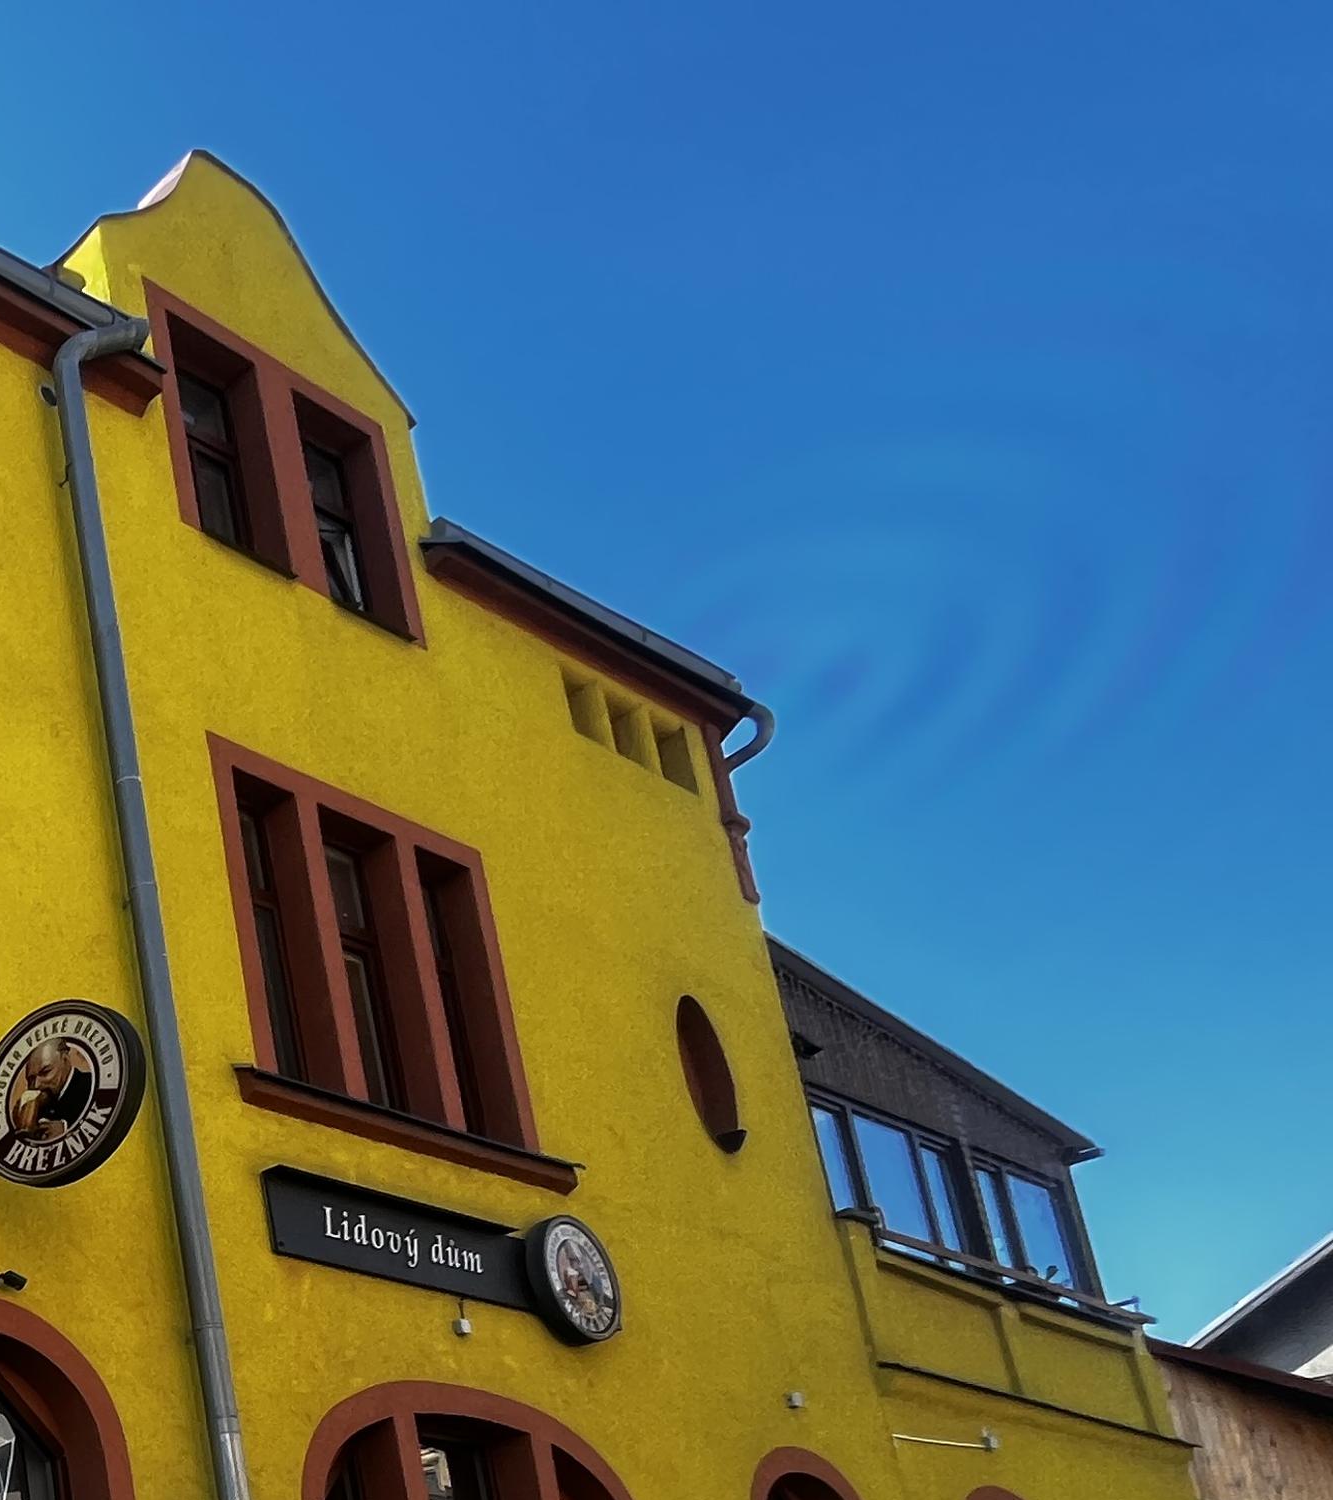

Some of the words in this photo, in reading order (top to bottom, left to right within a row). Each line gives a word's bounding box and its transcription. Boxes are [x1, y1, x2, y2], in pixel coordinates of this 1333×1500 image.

[26, 1017, 69, 1047] VELKÉ
[322, 1204, 420, 1268] Lidový
[431, 1234, 485, 1274] dům
